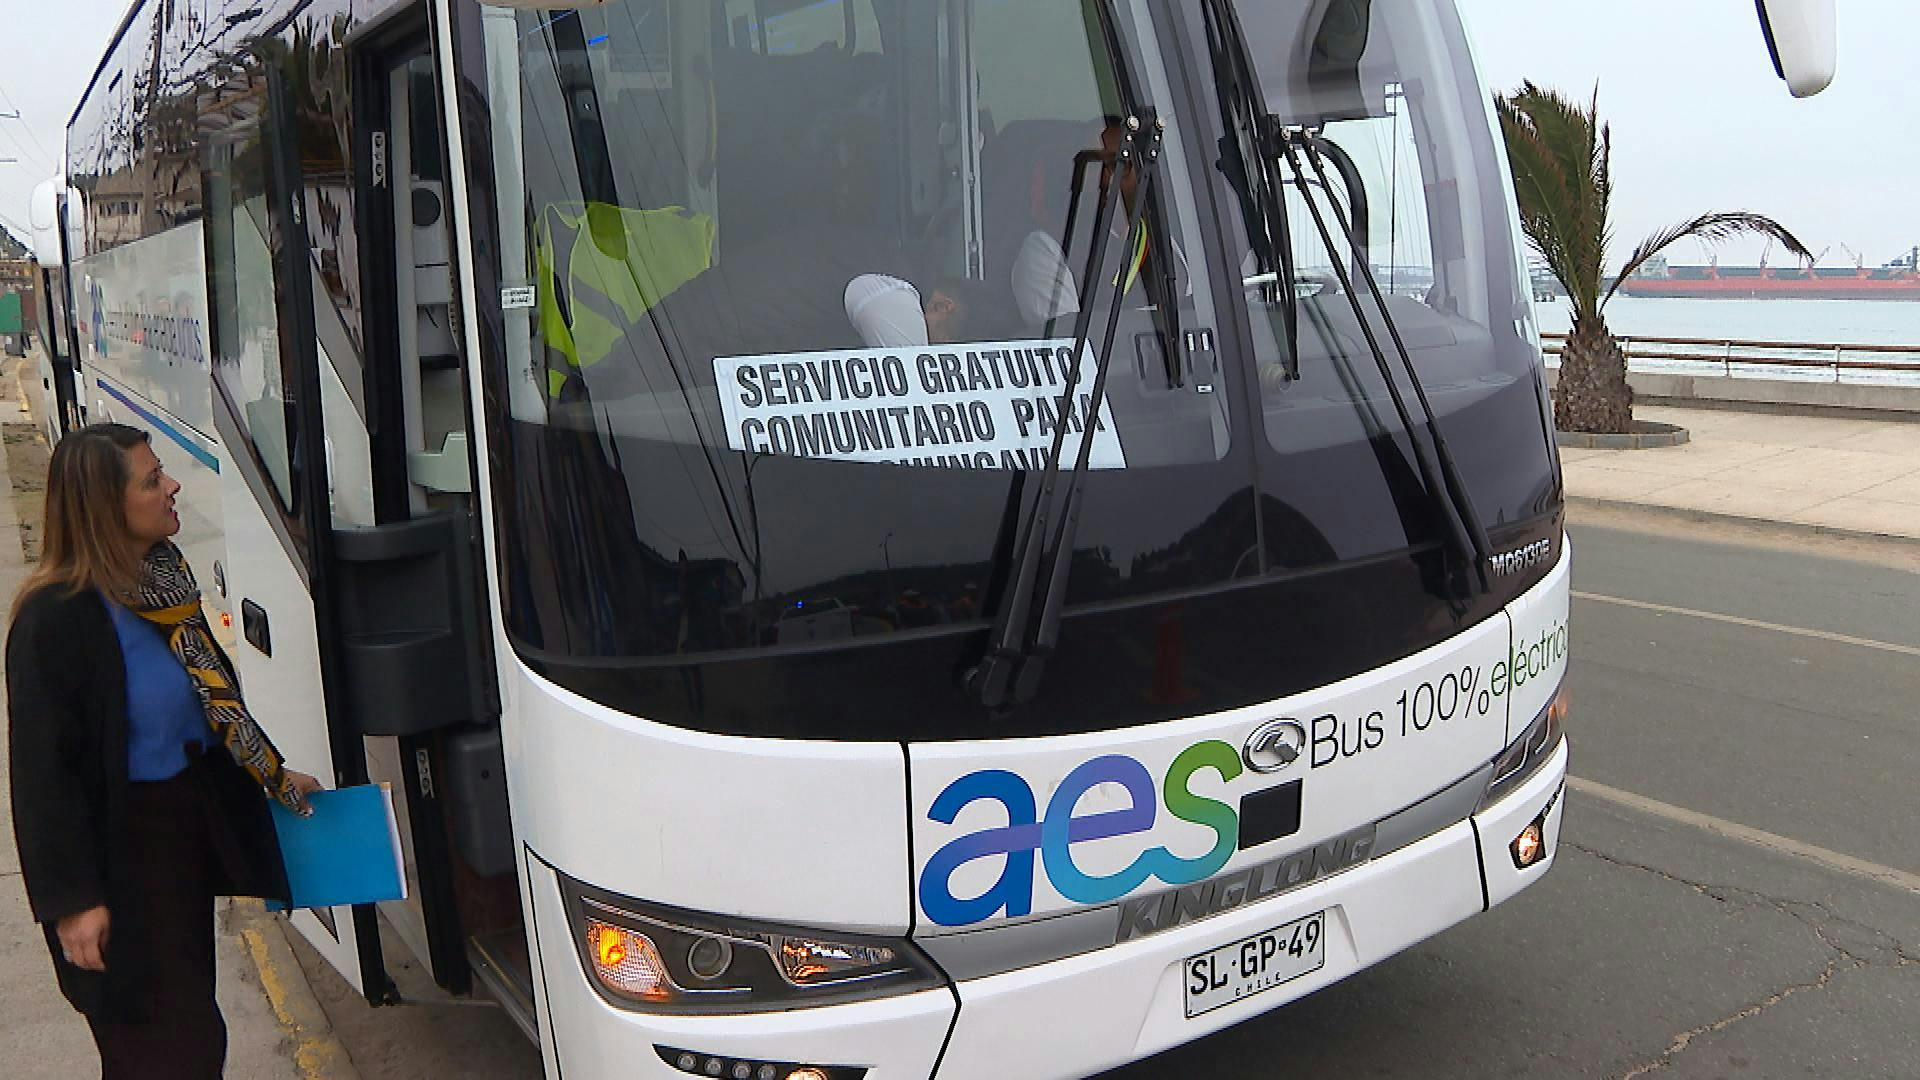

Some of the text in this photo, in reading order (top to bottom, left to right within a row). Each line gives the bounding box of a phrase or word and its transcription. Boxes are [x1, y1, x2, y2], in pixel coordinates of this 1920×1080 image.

[736, 345, 1081, 408] SERVICIO GRATUITO
[741, 400, 995, 457] COMUNITARIO
[1310, 619, 1568, 769] Bus 100% eléctric
[919, 739, 1243, 927] aes
[1235, 971, 1281, 997] CHILE
